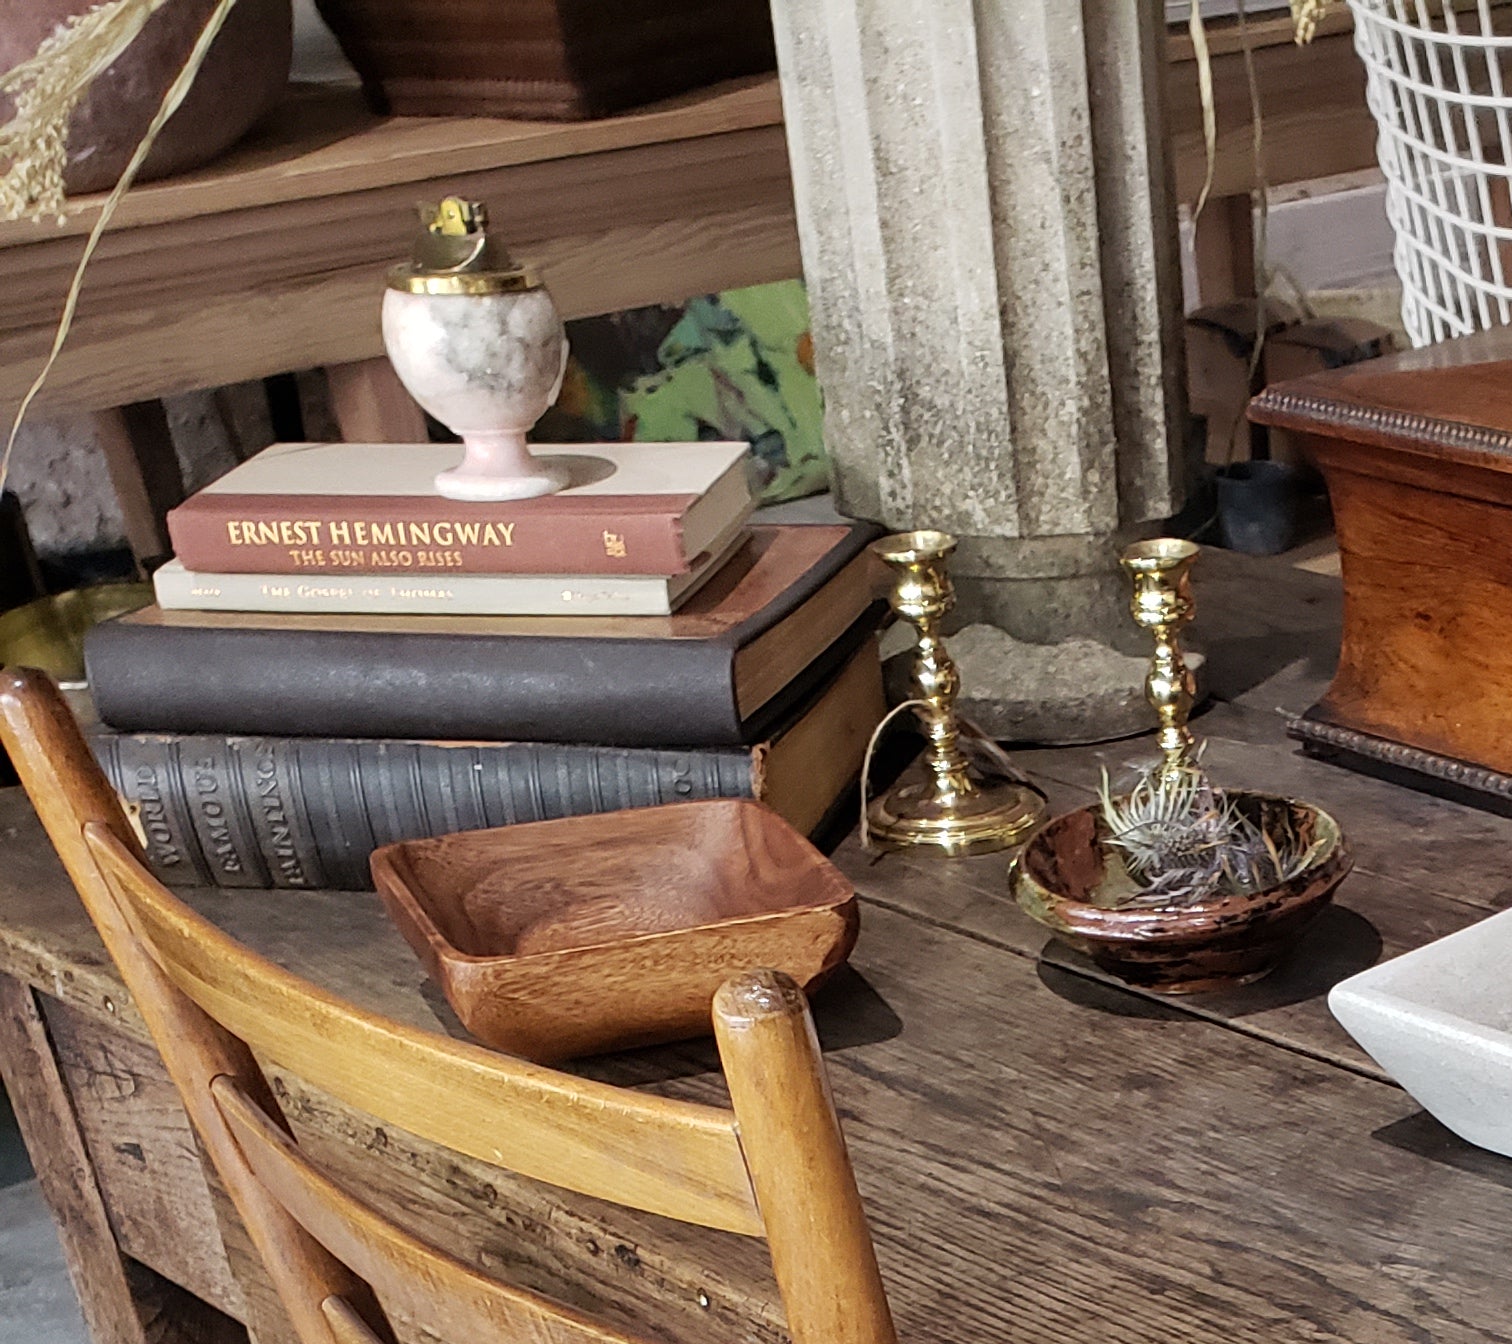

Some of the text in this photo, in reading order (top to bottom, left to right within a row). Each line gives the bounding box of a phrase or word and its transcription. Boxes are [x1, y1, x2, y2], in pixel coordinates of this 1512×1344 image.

[227, 520, 516, 547] ERNEST HEMINGWAY
[289, 550, 464, 568] THE SUN ALSO RISES
[136, 765, 181, 867] WORLD
[194, 757, 243, 874] FAMOUS
[254, 744, 305, 886] PAINTINGS
